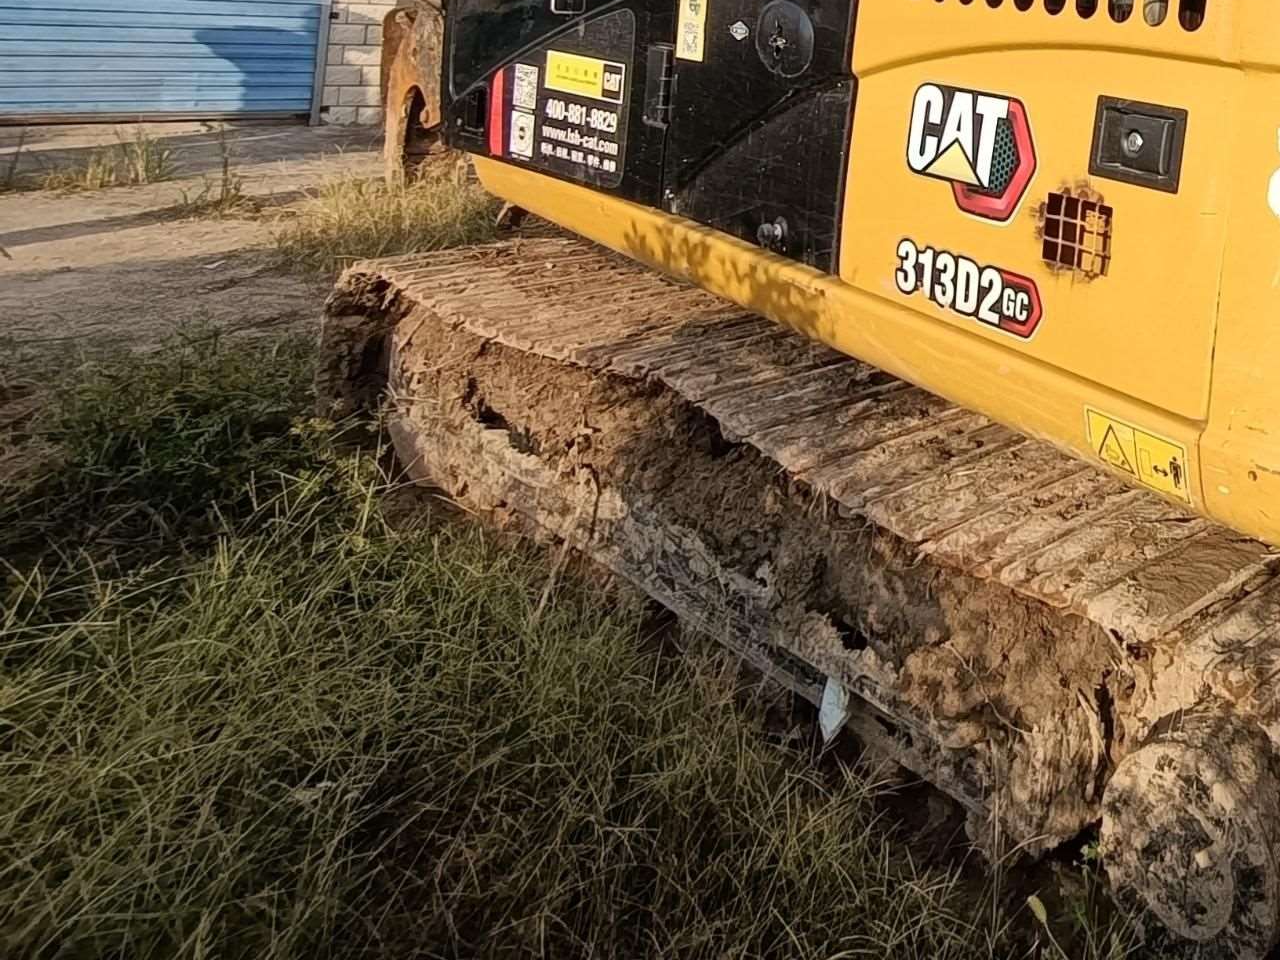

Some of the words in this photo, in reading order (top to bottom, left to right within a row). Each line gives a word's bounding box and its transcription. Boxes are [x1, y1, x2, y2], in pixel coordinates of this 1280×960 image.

[604, 72, 622, 92] CAT
[545, 98, 618, 133] 400-881-8829
[909, 82, 1009, 188] CAT
[896, 239, 1002, 325] 313D2
[1002, 290, 1030, 322] GC
